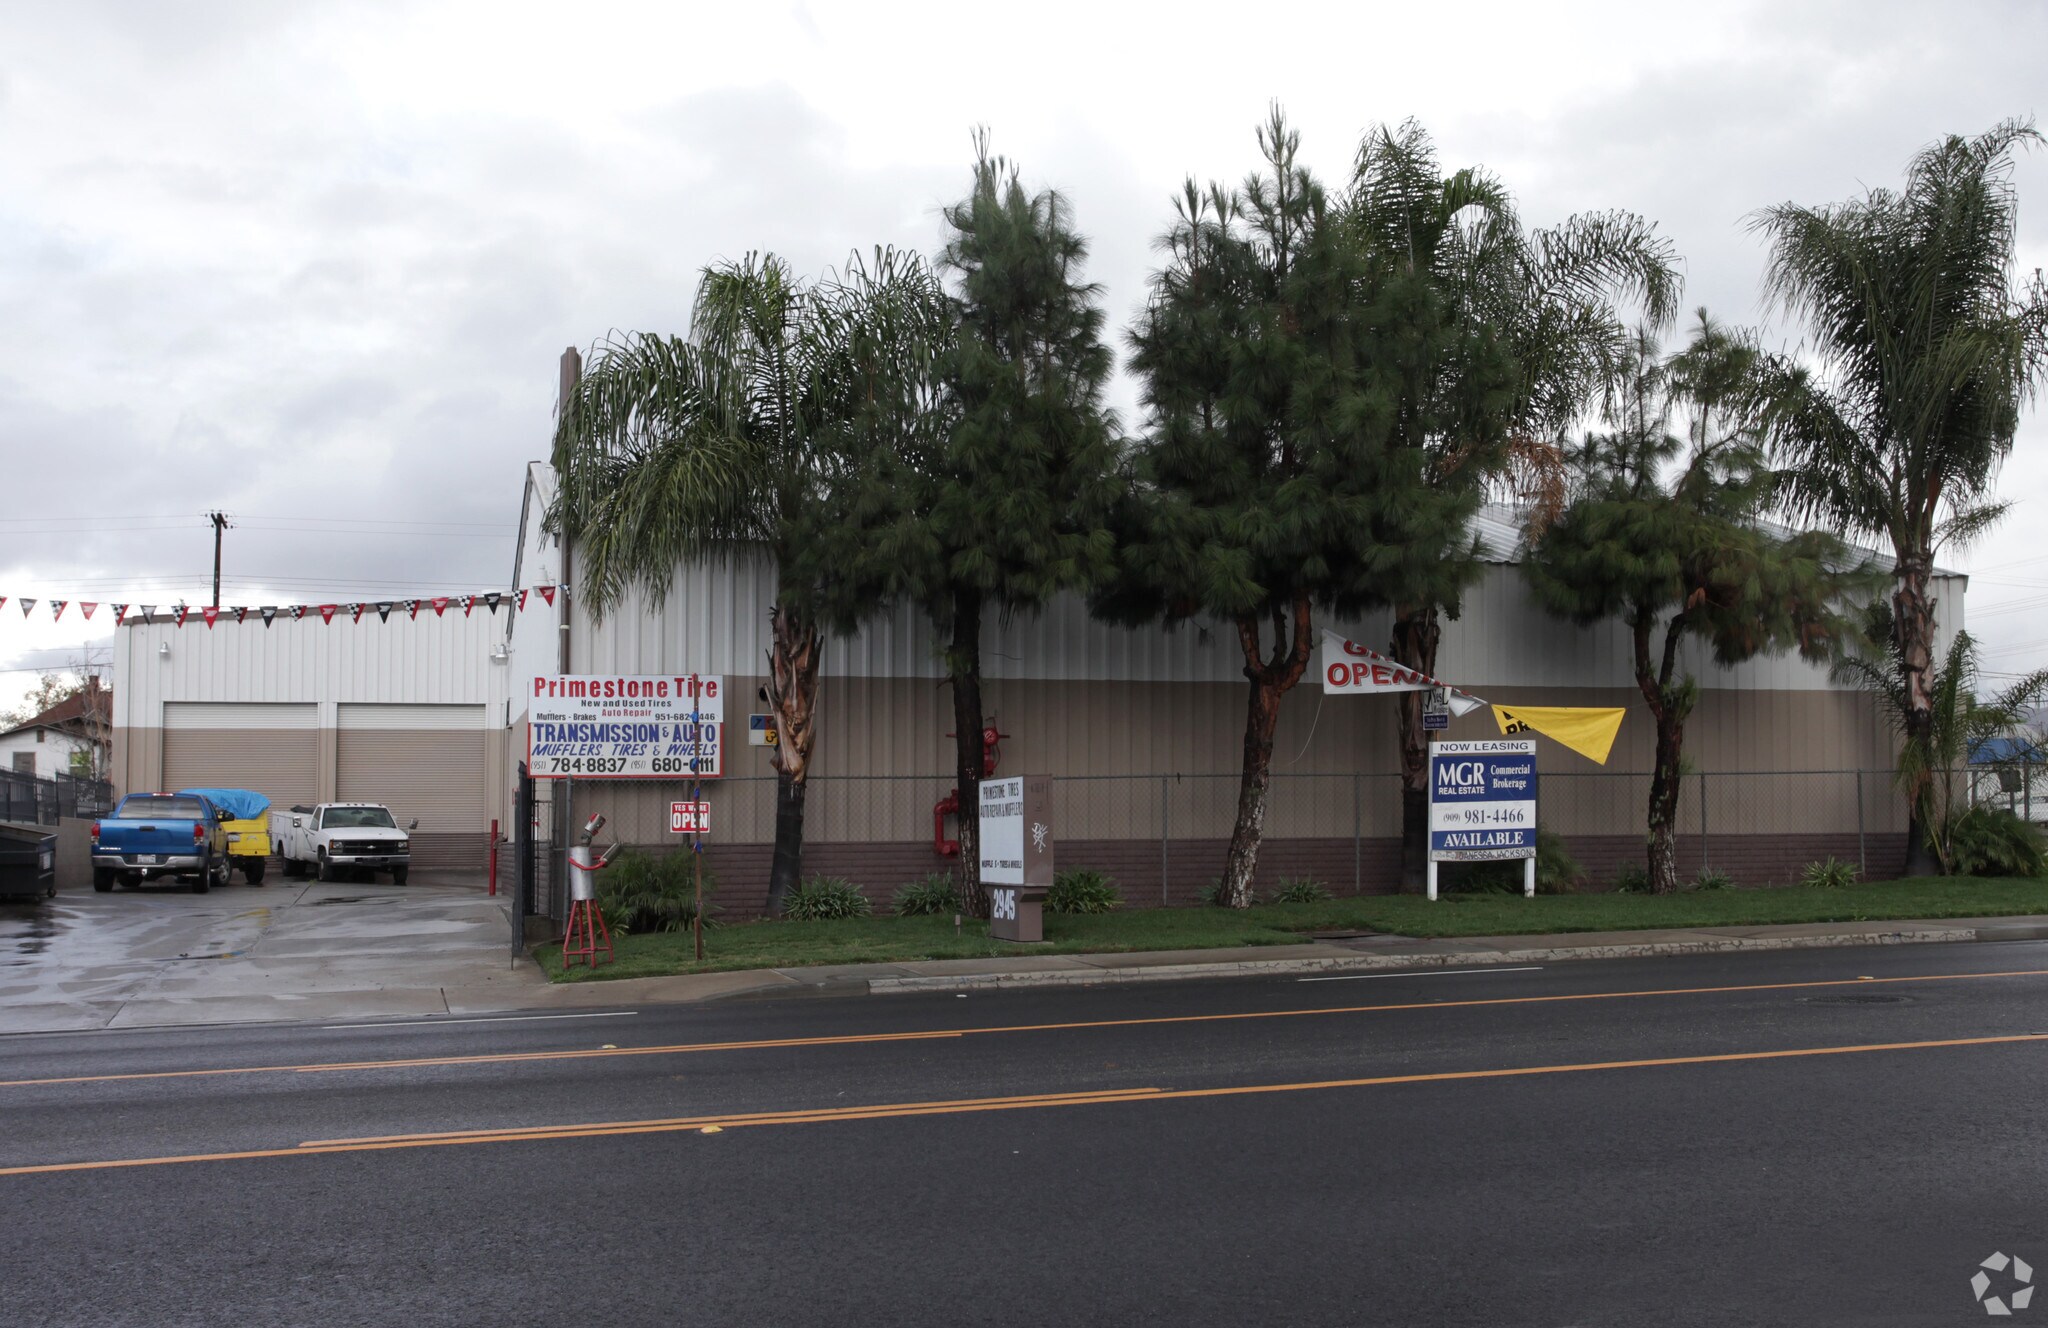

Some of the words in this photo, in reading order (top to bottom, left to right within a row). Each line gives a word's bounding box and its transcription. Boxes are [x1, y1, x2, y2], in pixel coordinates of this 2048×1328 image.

[534, 677, 668, 698] Primestone
[674, 677, 717, 698] Tire
[536, 713, 566, 721] Mufflers
[573, 713, 597, 721] Brakes
[623, 709, 651, 717] Repair
[534, 723, 660, 742] TRANSMISSION
[662, 726, 669, 738] &
[672, 724, 716, 742] AUTO
[612, 743, 647, 756] TIRES
[666, 743, 717, 756] WHEELS
[1440, 743, 1470, 751] NOW
[1474, 742, 1529, 751] LEASING
[551, 758, 627, 773] 784-8837
[1490, 764, 1530, 775] Commercial
[1438, 762, 1485, 786] MGR
[1438, 787, 1457, 795] REAL
[1458, 787, 1485, 795] ESTATE
[1492, 778, 1527, 790] Brokerage
[674, 804, 686, 812] YES
[673, 813, 708, 828] OPEN
[1443, 812, 1460, 823] (909)
[1464, 808, 1524, 824] 981-4466
[1443, 831, 1524, 847] AVAILABLE
[994, 889, 1015, 920] 2945
